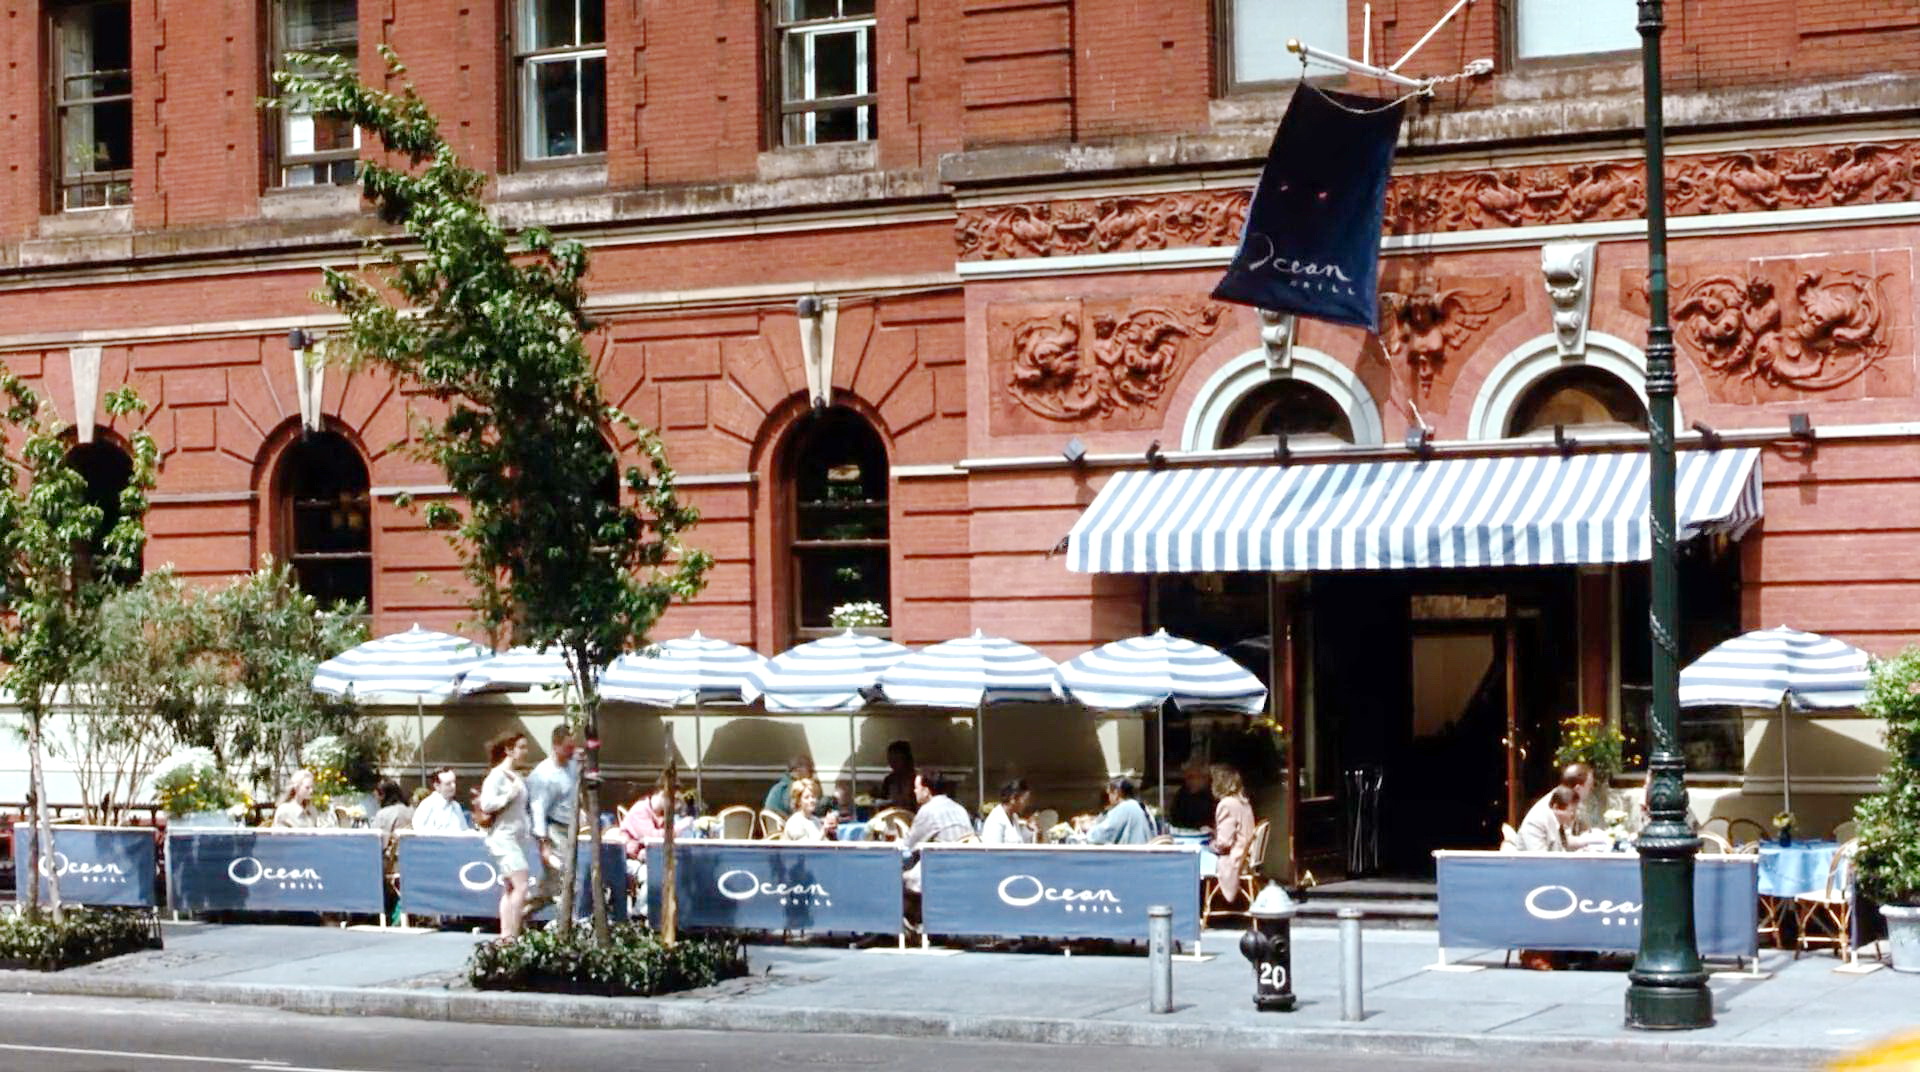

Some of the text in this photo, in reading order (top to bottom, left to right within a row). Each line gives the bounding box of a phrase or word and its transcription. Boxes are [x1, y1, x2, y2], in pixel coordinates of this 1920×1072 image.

[1247, 231, 1353, 282] Ocean
[38, 851, 124, 876] Ocean
[227, 856, 321, 885] Ocean
[717, 870, 830, 900] Ocean
[997, 875, 1120, 907] Ocean
[1525, 885, 1643, 919] Ocea
[1260, 962, 1286, 989] 20
